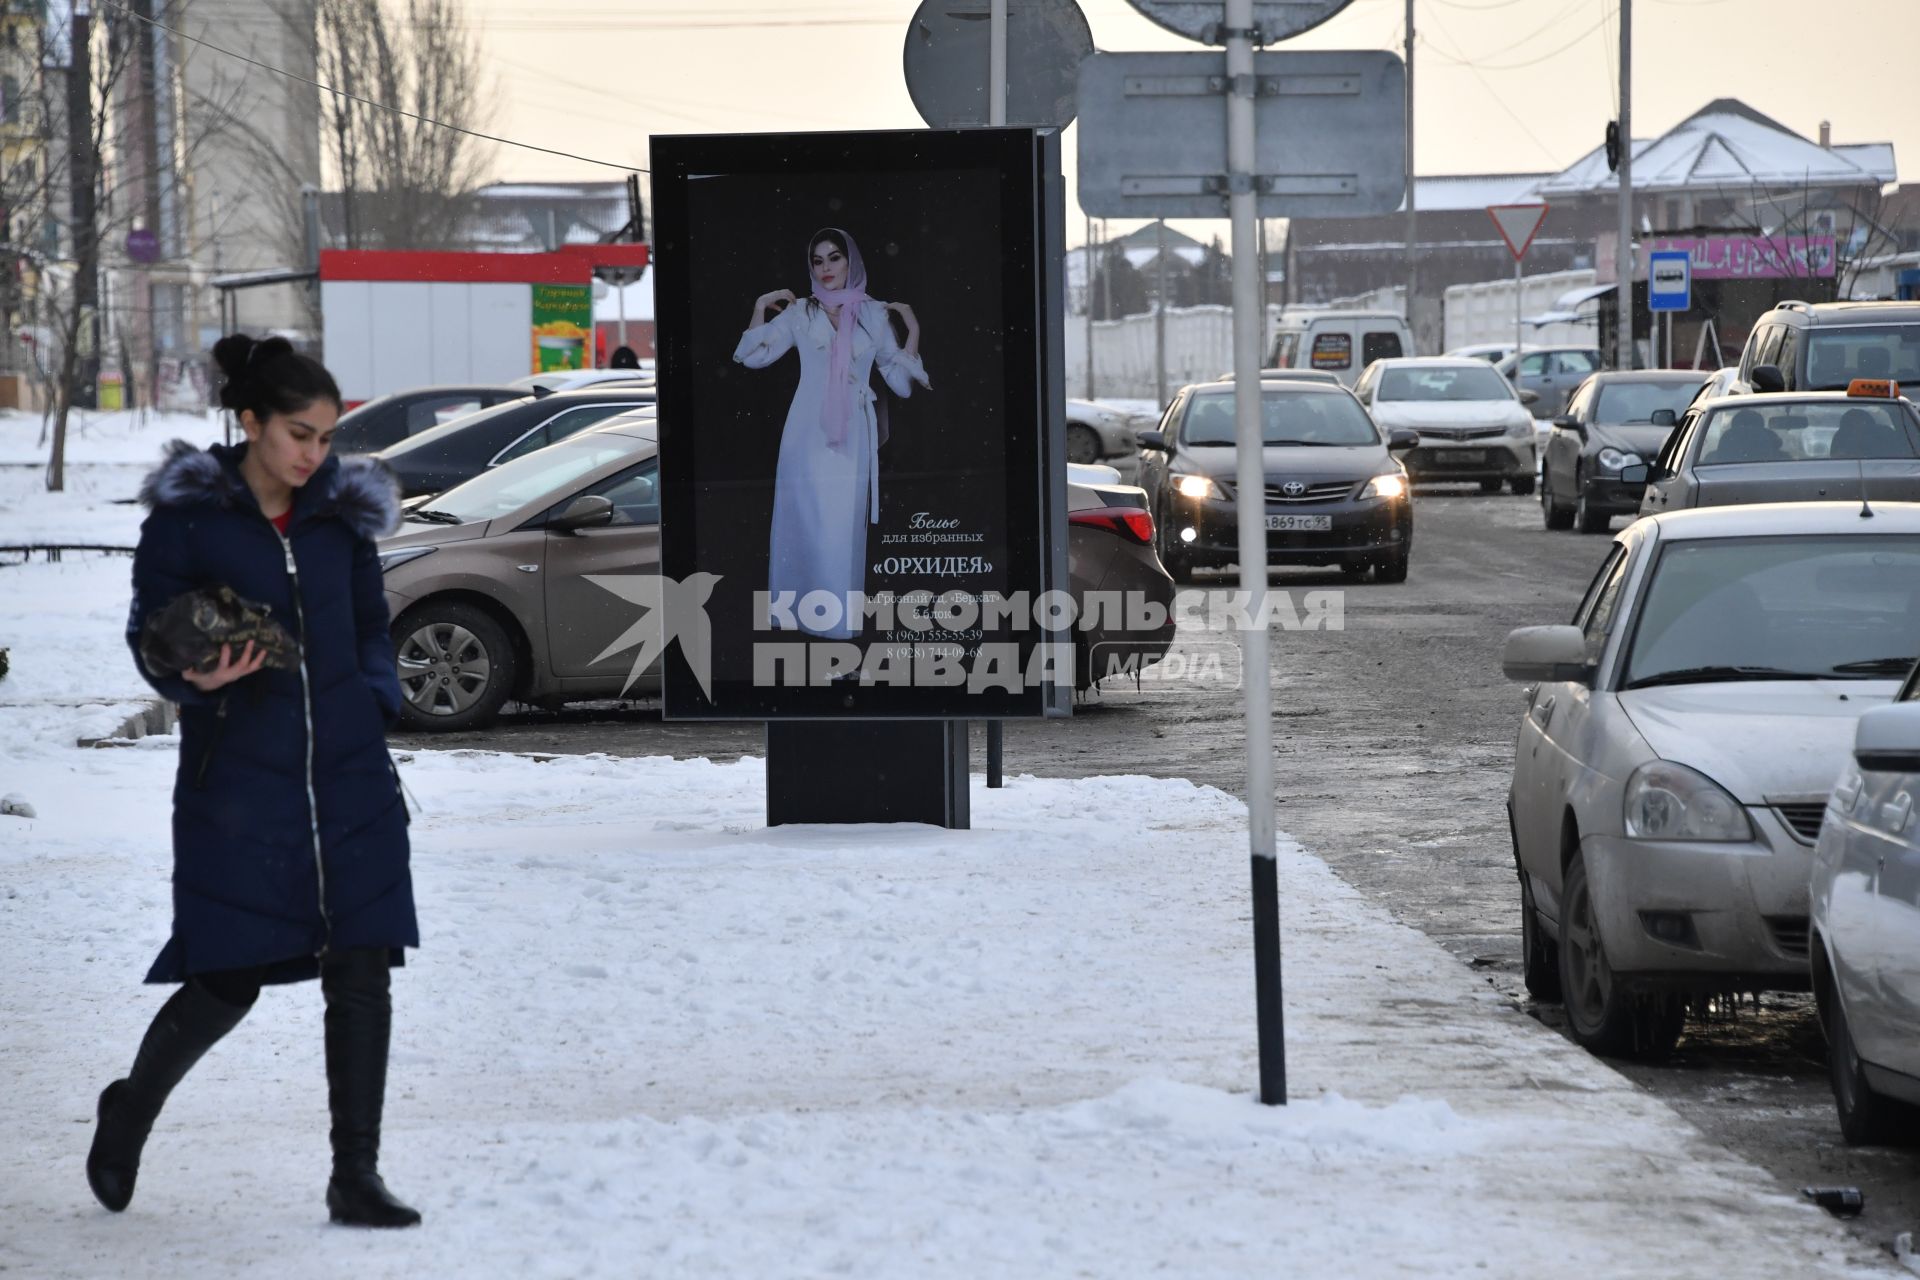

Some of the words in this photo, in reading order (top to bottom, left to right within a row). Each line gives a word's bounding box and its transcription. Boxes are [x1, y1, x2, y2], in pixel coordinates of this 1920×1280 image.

[909, 512, 960, 529] Белье
[882, 534, 908, 545] для
[911, 531, 984, 545] избранных
[873, 556, 993, 578] «ОРХИДЕЯ»
[886, 631, 893, 641] 8
[896, 630, 925, 642] (962)
[928, 630, 983, 641] 555-55-39
[886, 648, 893, 658] 8
[896, 647, 925, 659] (928)
[930, 648, 983, 659] 744-09-68
